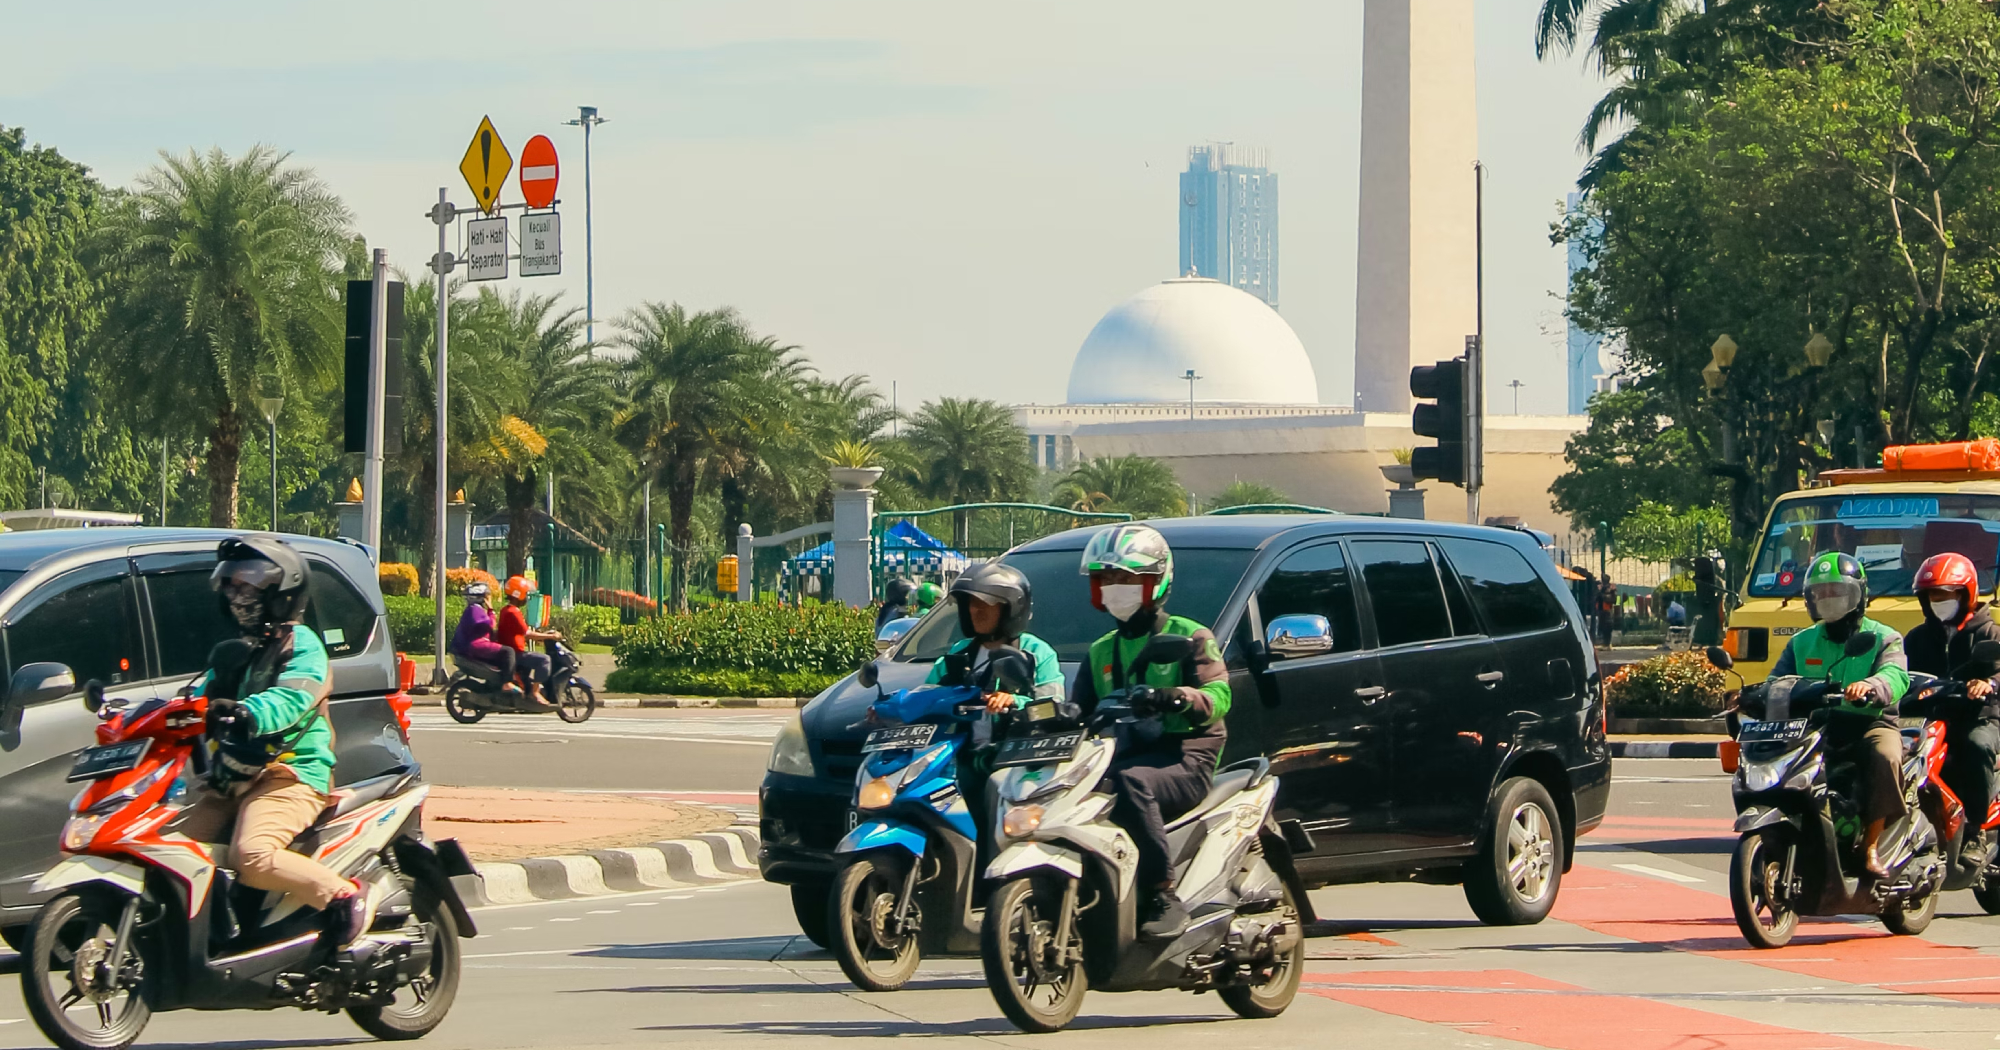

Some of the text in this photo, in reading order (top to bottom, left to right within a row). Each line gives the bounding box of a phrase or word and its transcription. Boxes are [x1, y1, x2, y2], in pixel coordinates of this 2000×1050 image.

[529, 220, 551, 233] Kecuali
[471, 228, 485, 246] Hati
[490, 226, 504, 243] Hati
[535, 238, 545, 250] Bus
[471, 251, 504, 272] Separator
[523, 251, 558, 269] Transjakarta
[1772, 627, 1798, 636] COLT
[910, 725, 934, 736] KPS
[1053, 734, 1080, 747] PFT
[849, 811, 858, 831] B
